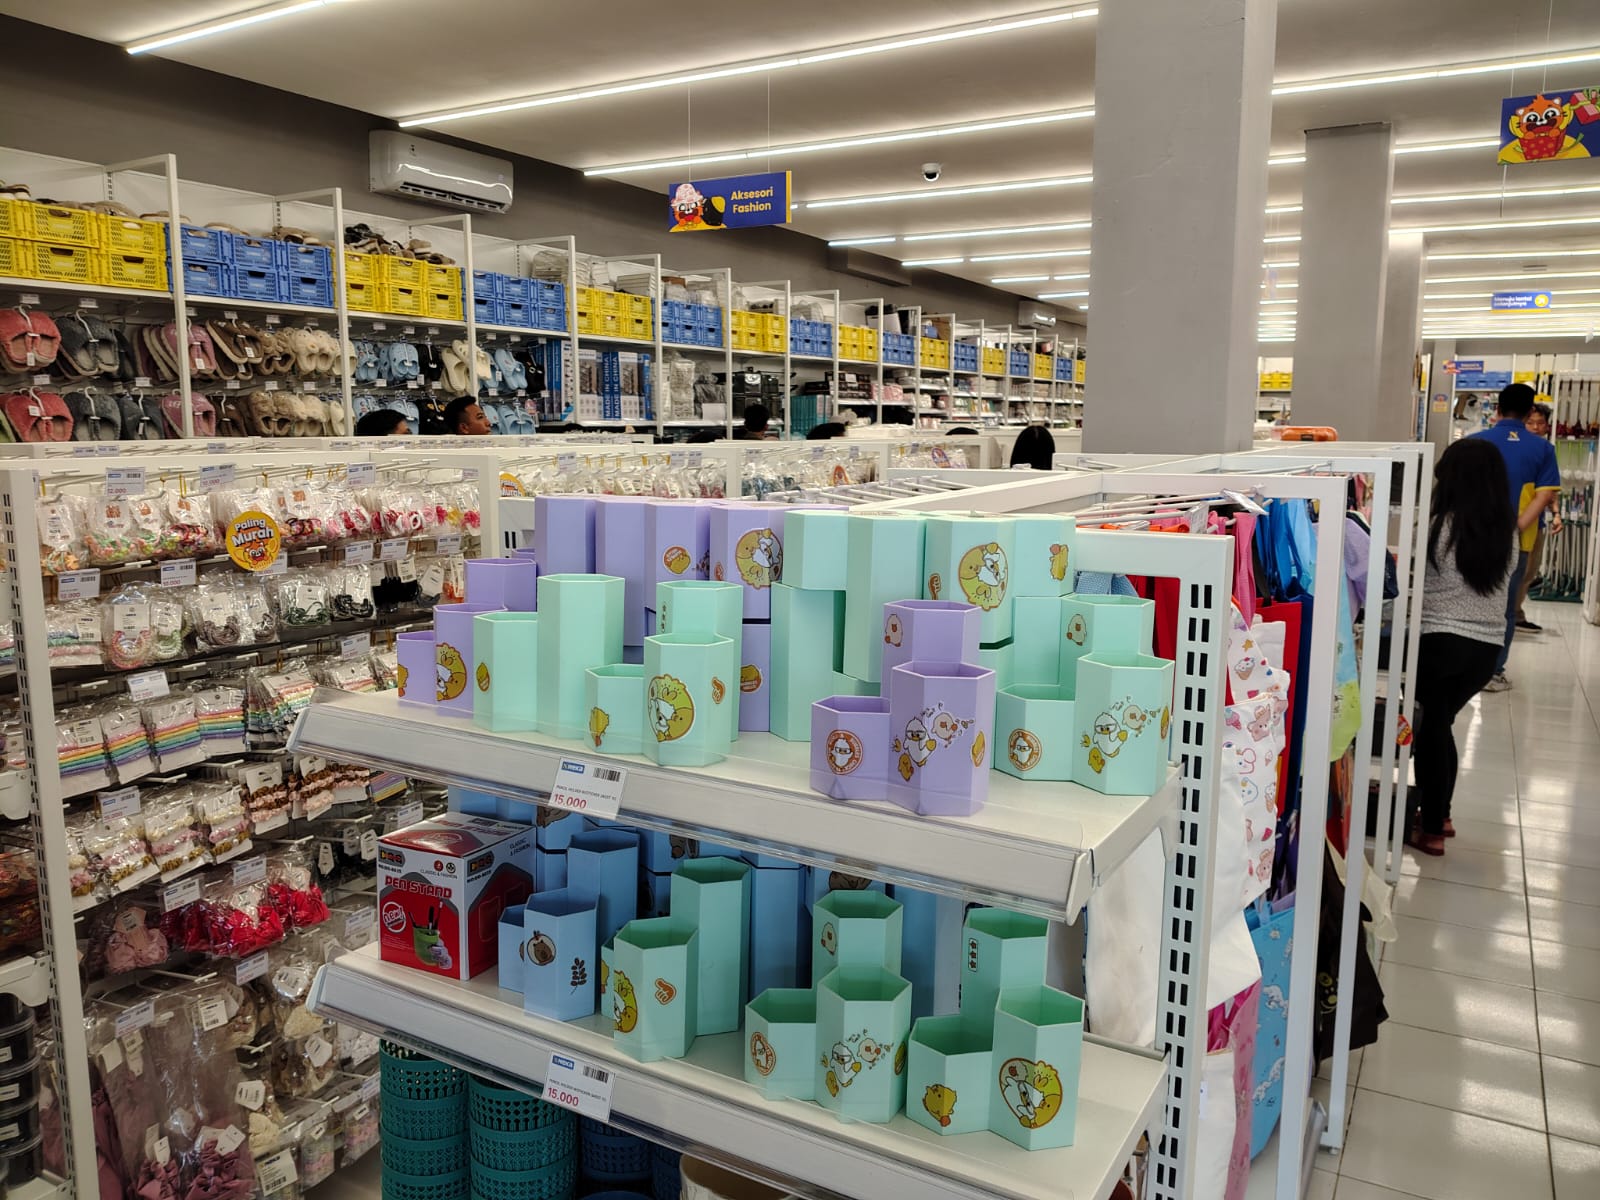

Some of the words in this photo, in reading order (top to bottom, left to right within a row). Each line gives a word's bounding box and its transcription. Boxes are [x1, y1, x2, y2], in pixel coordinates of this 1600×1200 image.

[731, 186, 773, 201] Aksesori
[732, 201, 771, 214] Fashion
[604, 384, 610, 392] IN
[613, 384, 619, 392] IN
[235, 518, 266, 532] Paling
[231, 527, 275, 547] Murah
[553, 793, 588, 809] 15.000
[384, 875, 408, 890] PEN
[408, 880, 453, 899] STAND
[547, 1087, 579, 1107] 15.000
